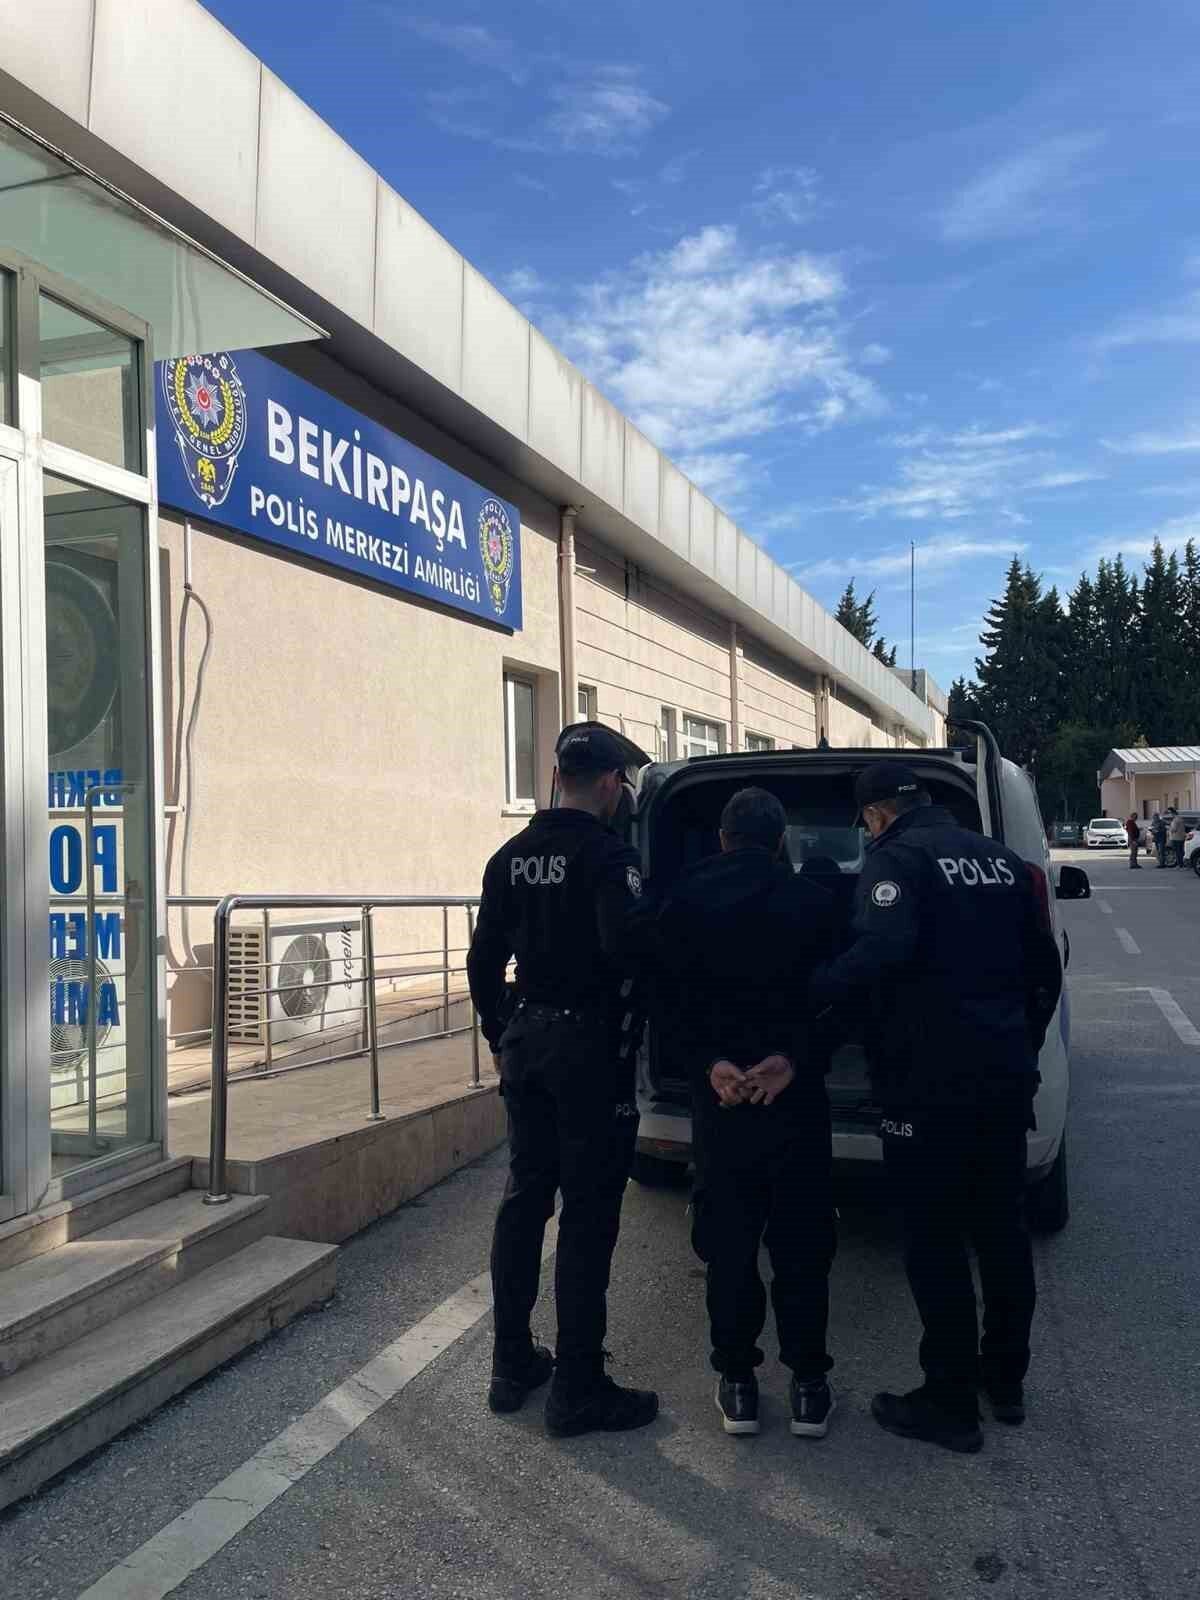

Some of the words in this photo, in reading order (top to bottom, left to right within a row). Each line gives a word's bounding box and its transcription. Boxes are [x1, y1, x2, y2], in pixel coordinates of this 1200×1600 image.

[267, 399, 468, 552] BEKİRPAŞA
[250, 485, 319, 540] POLİS
[325, 517, 409, 575] MERKEZİ
[414, 555, 481, 603] AMİRLİĞİ
